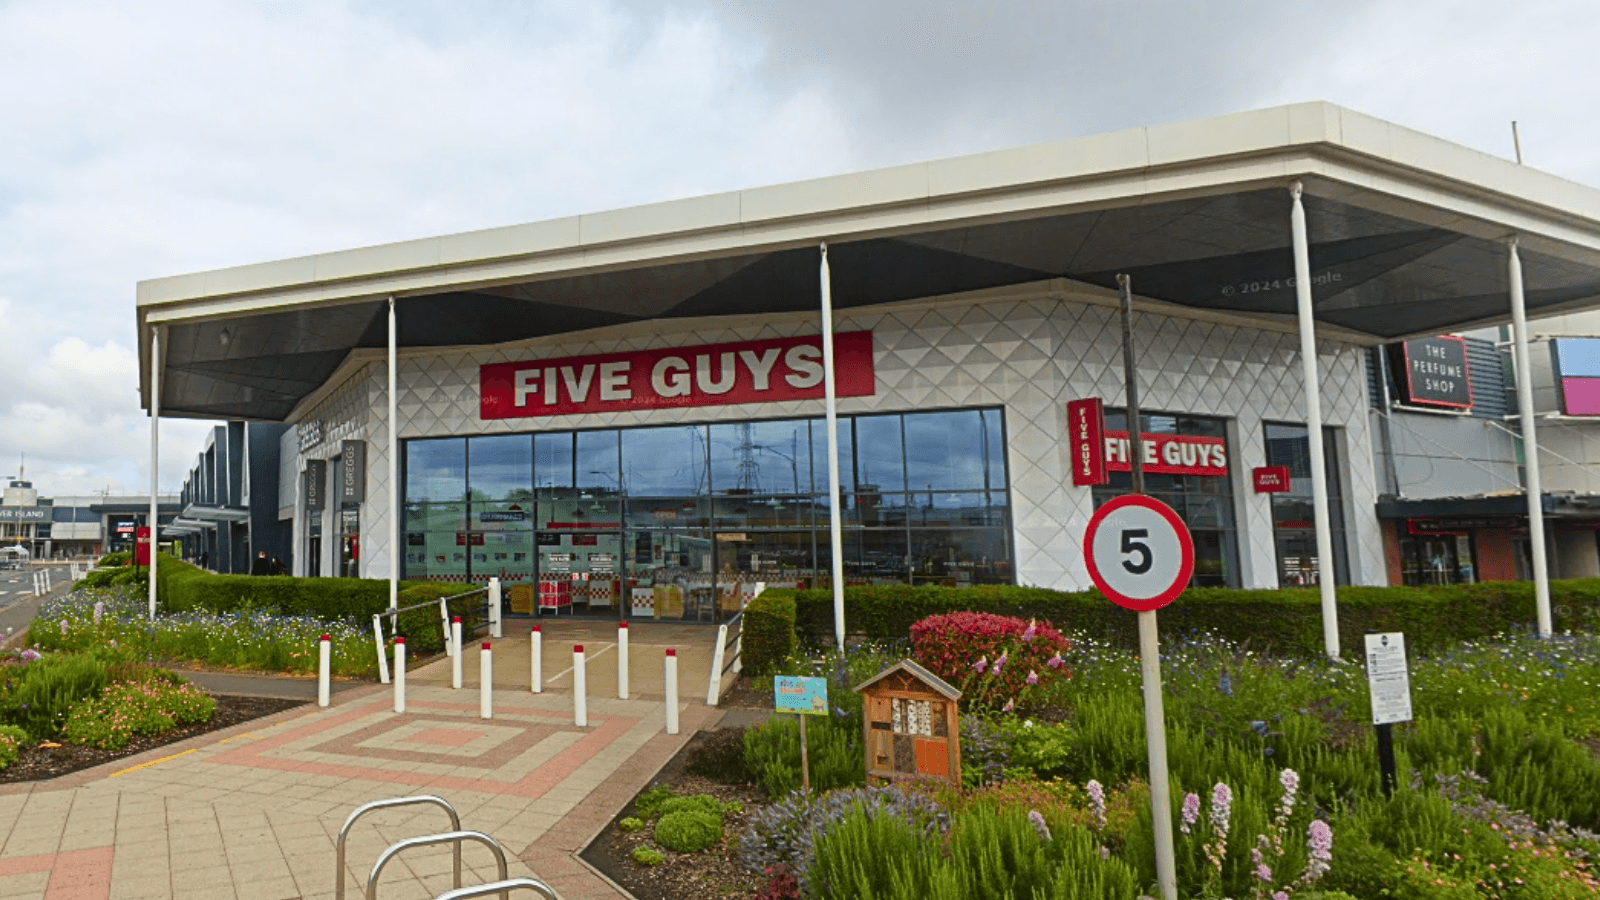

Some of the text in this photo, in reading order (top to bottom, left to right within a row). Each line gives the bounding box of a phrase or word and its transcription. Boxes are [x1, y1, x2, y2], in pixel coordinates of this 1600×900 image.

[1425, 344, 1446, 359] THE
[514, 344, 826, 408] FIVE GUYS
[1413, 360, 1462, 377] PERFUME
[1426, 378, 1454, 392] SHOP
[1079, 407, 1092, 476] FIVE GUYS
[1161, 441, 1227, 468] GUYS
[345, 445, 354, 487] GREGGS
[15, 510, 44, 518] ISLAND
[1120, 529, 1153, 574] 5
